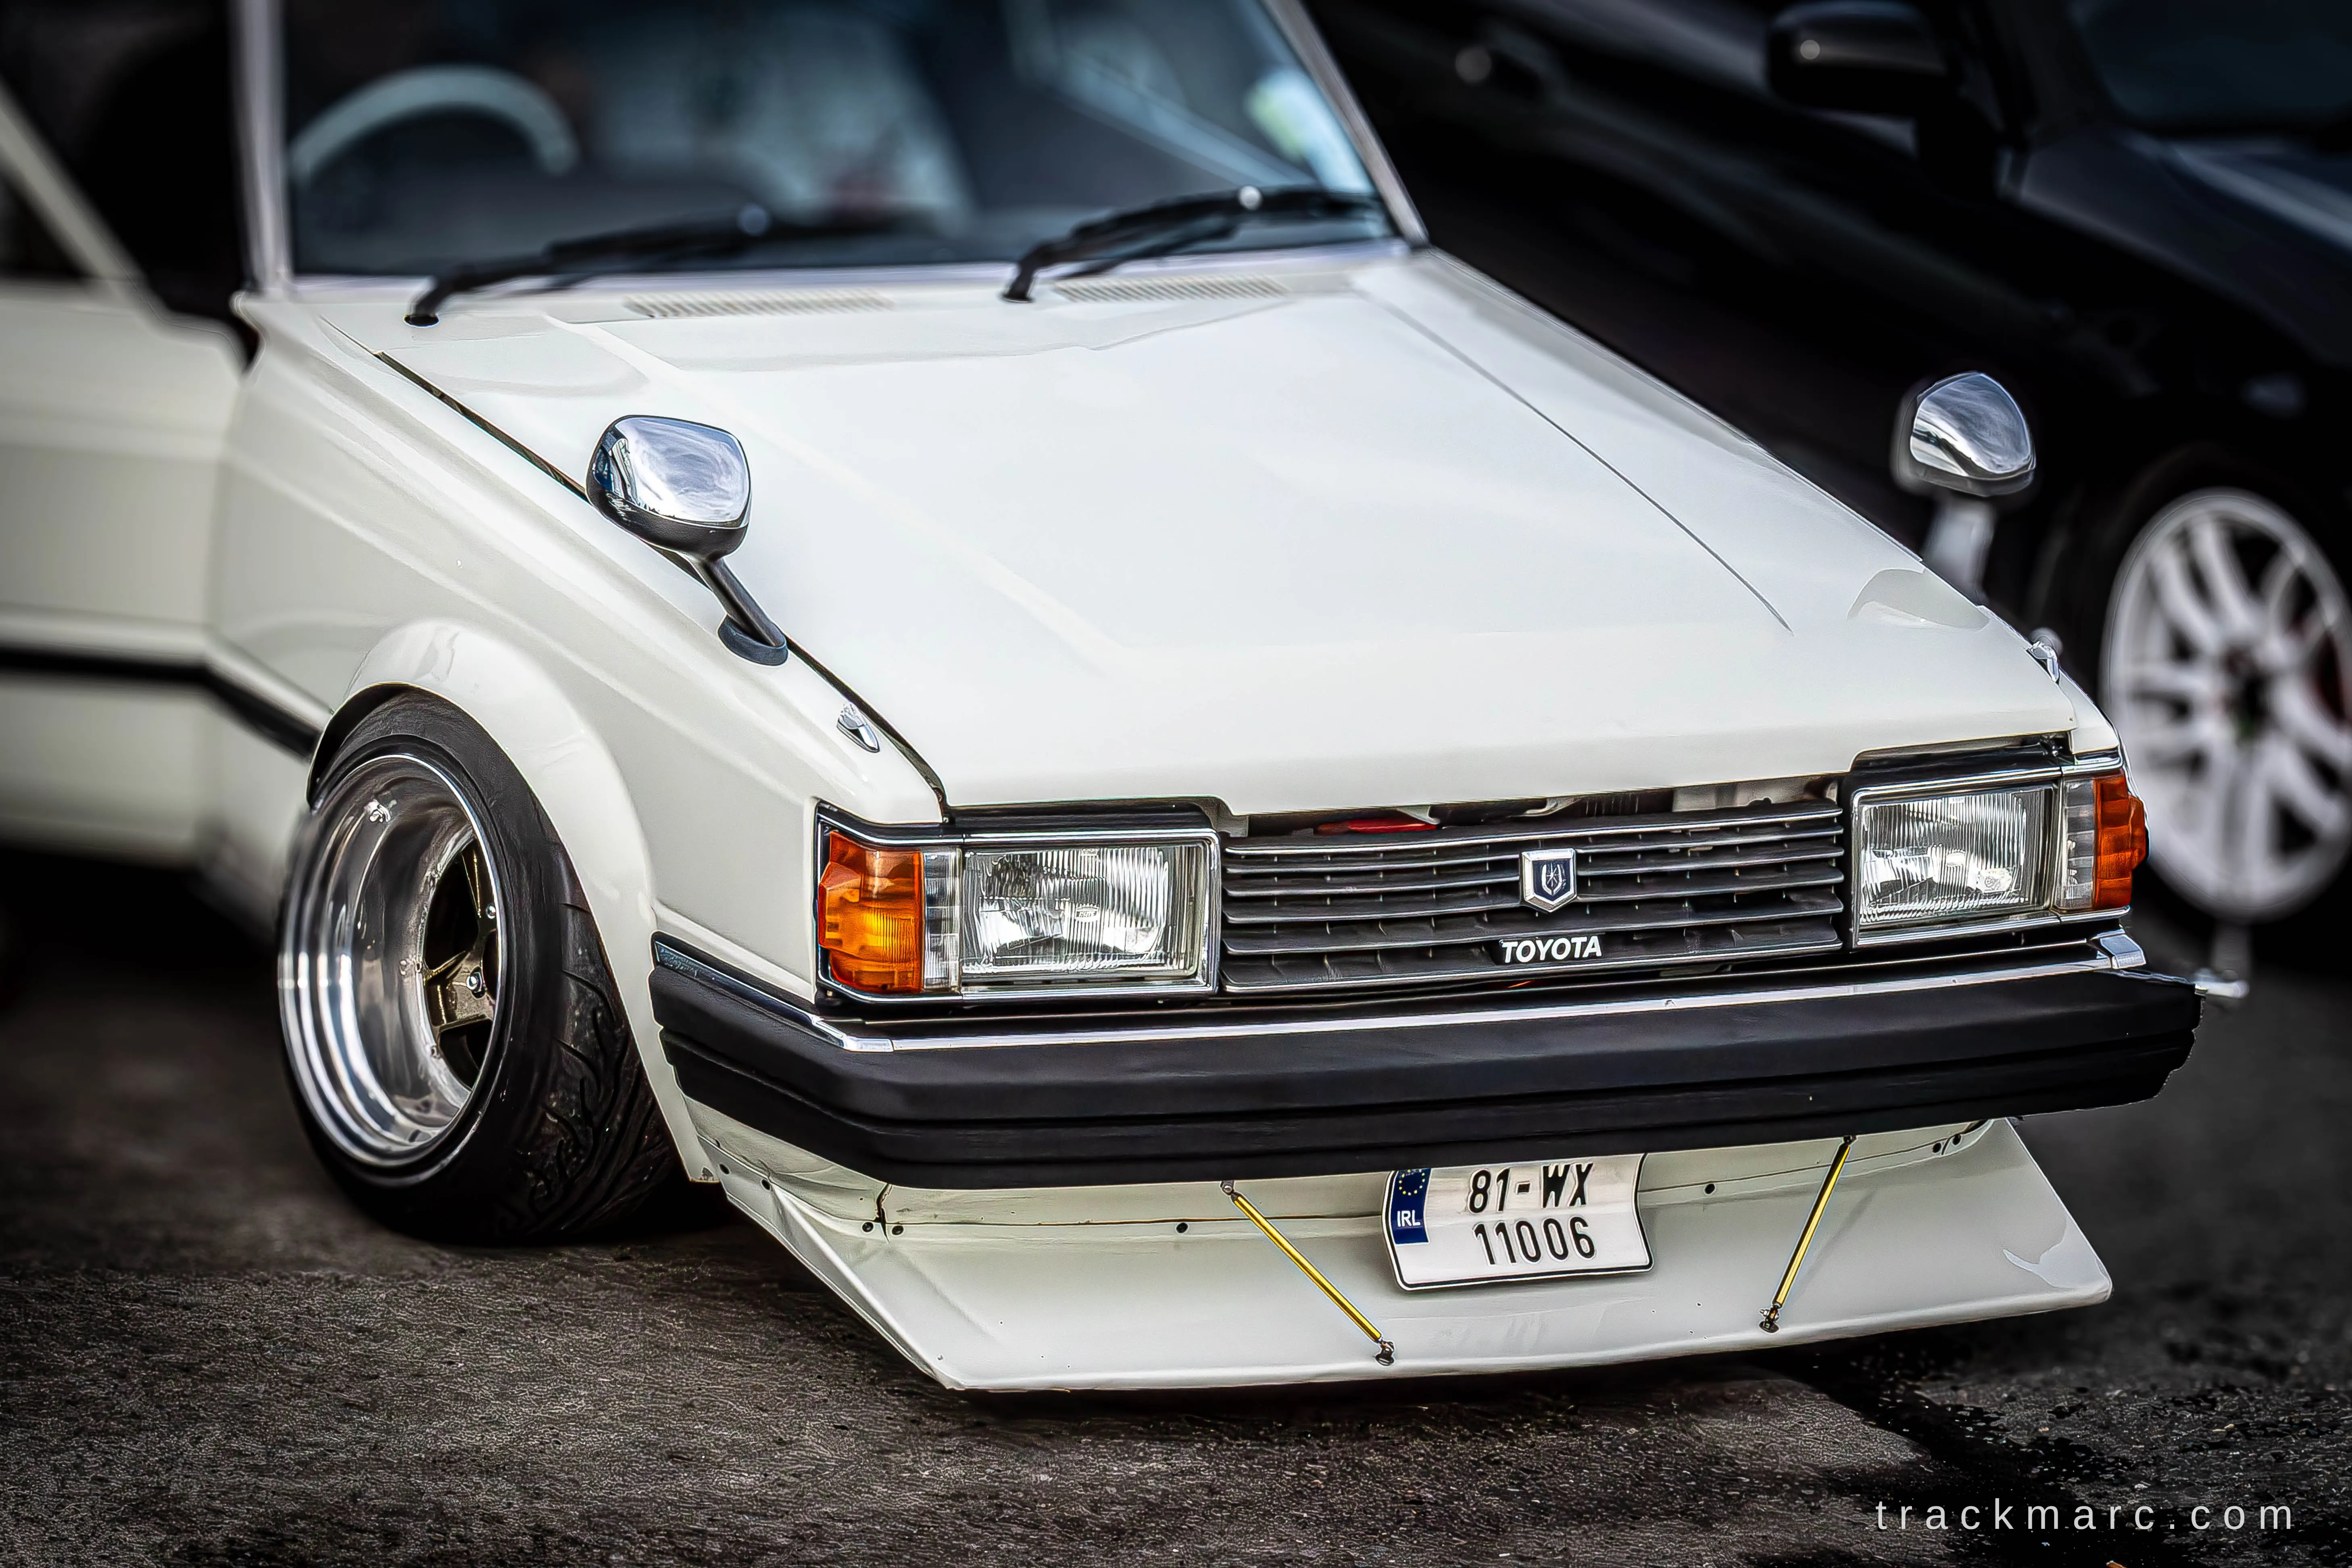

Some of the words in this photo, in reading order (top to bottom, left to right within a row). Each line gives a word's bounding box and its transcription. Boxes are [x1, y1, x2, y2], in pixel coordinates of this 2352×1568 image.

[1500, 935, 1602, 963] TOYOTA
[1469, 1162, 1594, 1214] 81-WX
[1397, 1209, 1421, 1228] IRL
[1474, 1216, 1595, 1265] 11006
